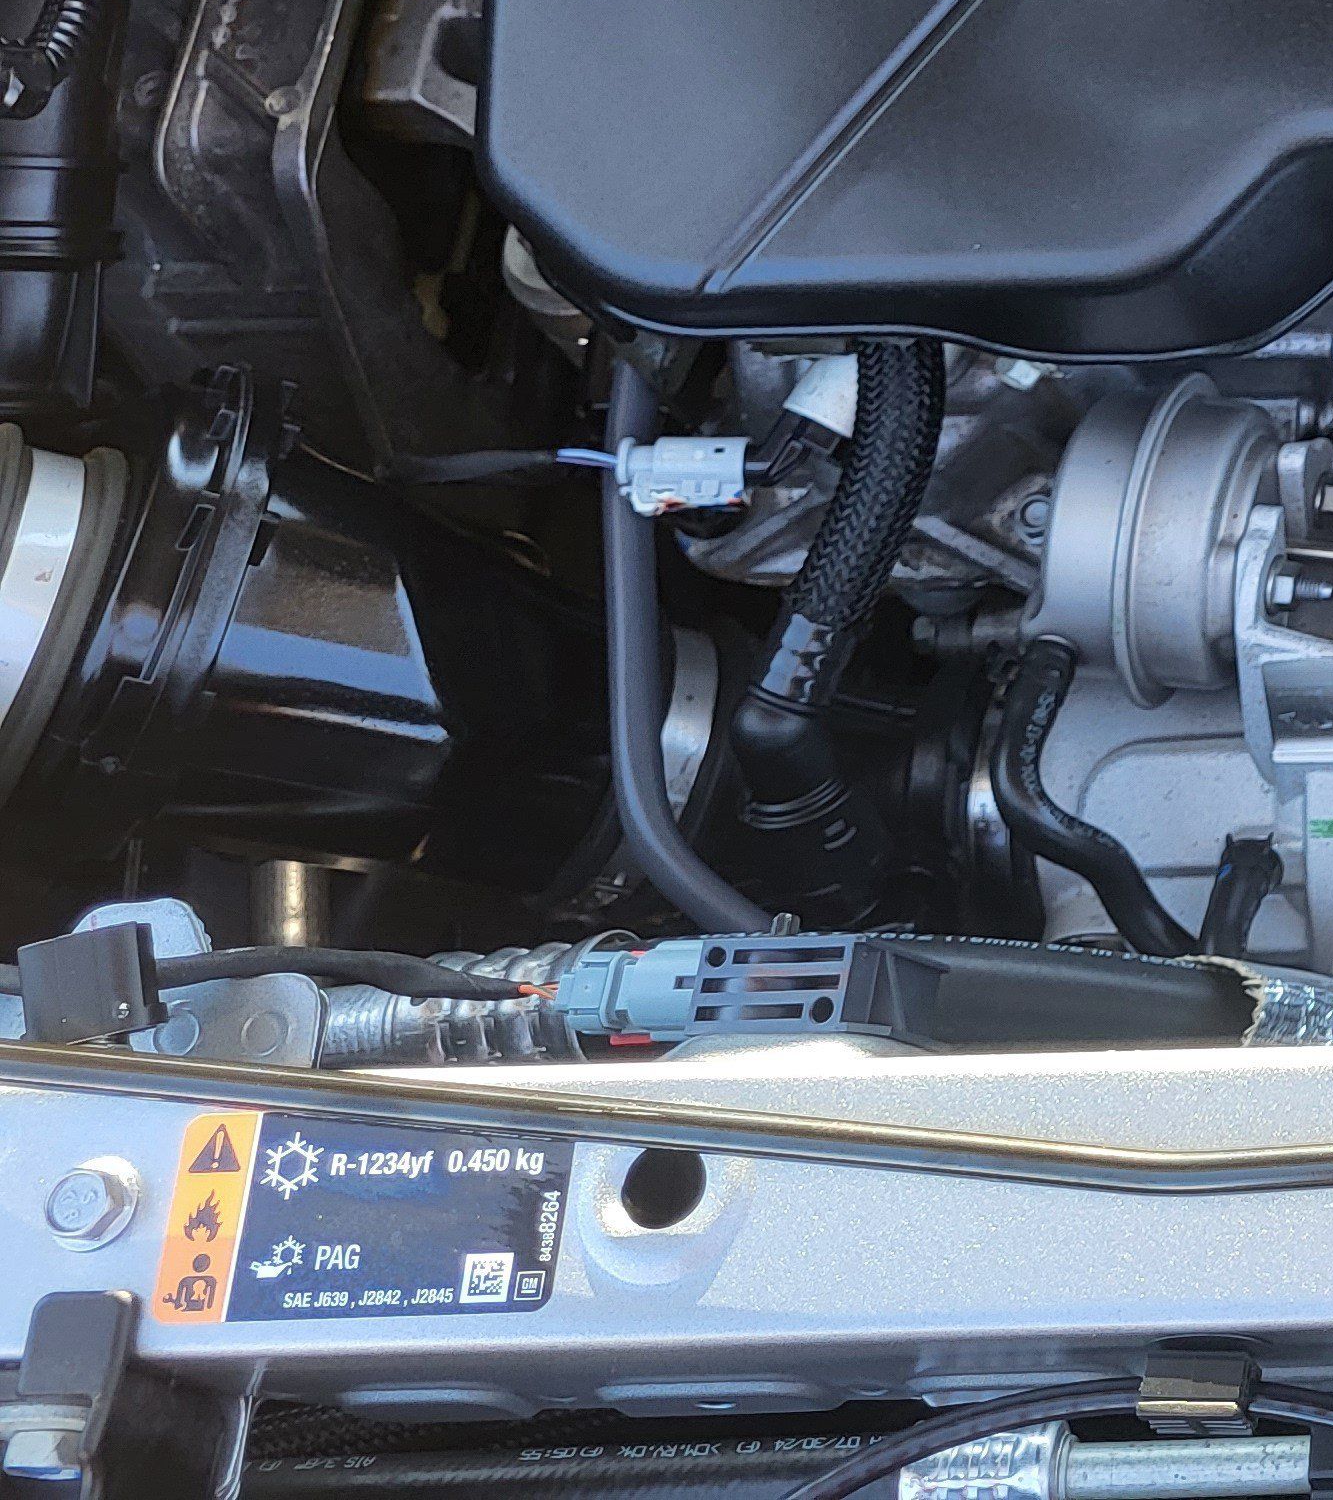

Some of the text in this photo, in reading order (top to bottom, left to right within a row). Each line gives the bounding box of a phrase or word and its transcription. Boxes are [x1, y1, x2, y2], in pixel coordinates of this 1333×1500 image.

[329, 1148, 545, 1179] R-1234yf 0.450 kg
[540, 1190, 561, 1262] 84388264
[314, 1244, 361, 1271] PAG
[521, 1277, 538, 1293] GM
[283, 1293, 310, 1308] SAE
[314, 1290, 348, 1307] J639
[358, 1288, 401, 1306] J2842
[411, 1288, 453, 1304] J2845
[773, 1436, 860, 1451] 07/30/24
